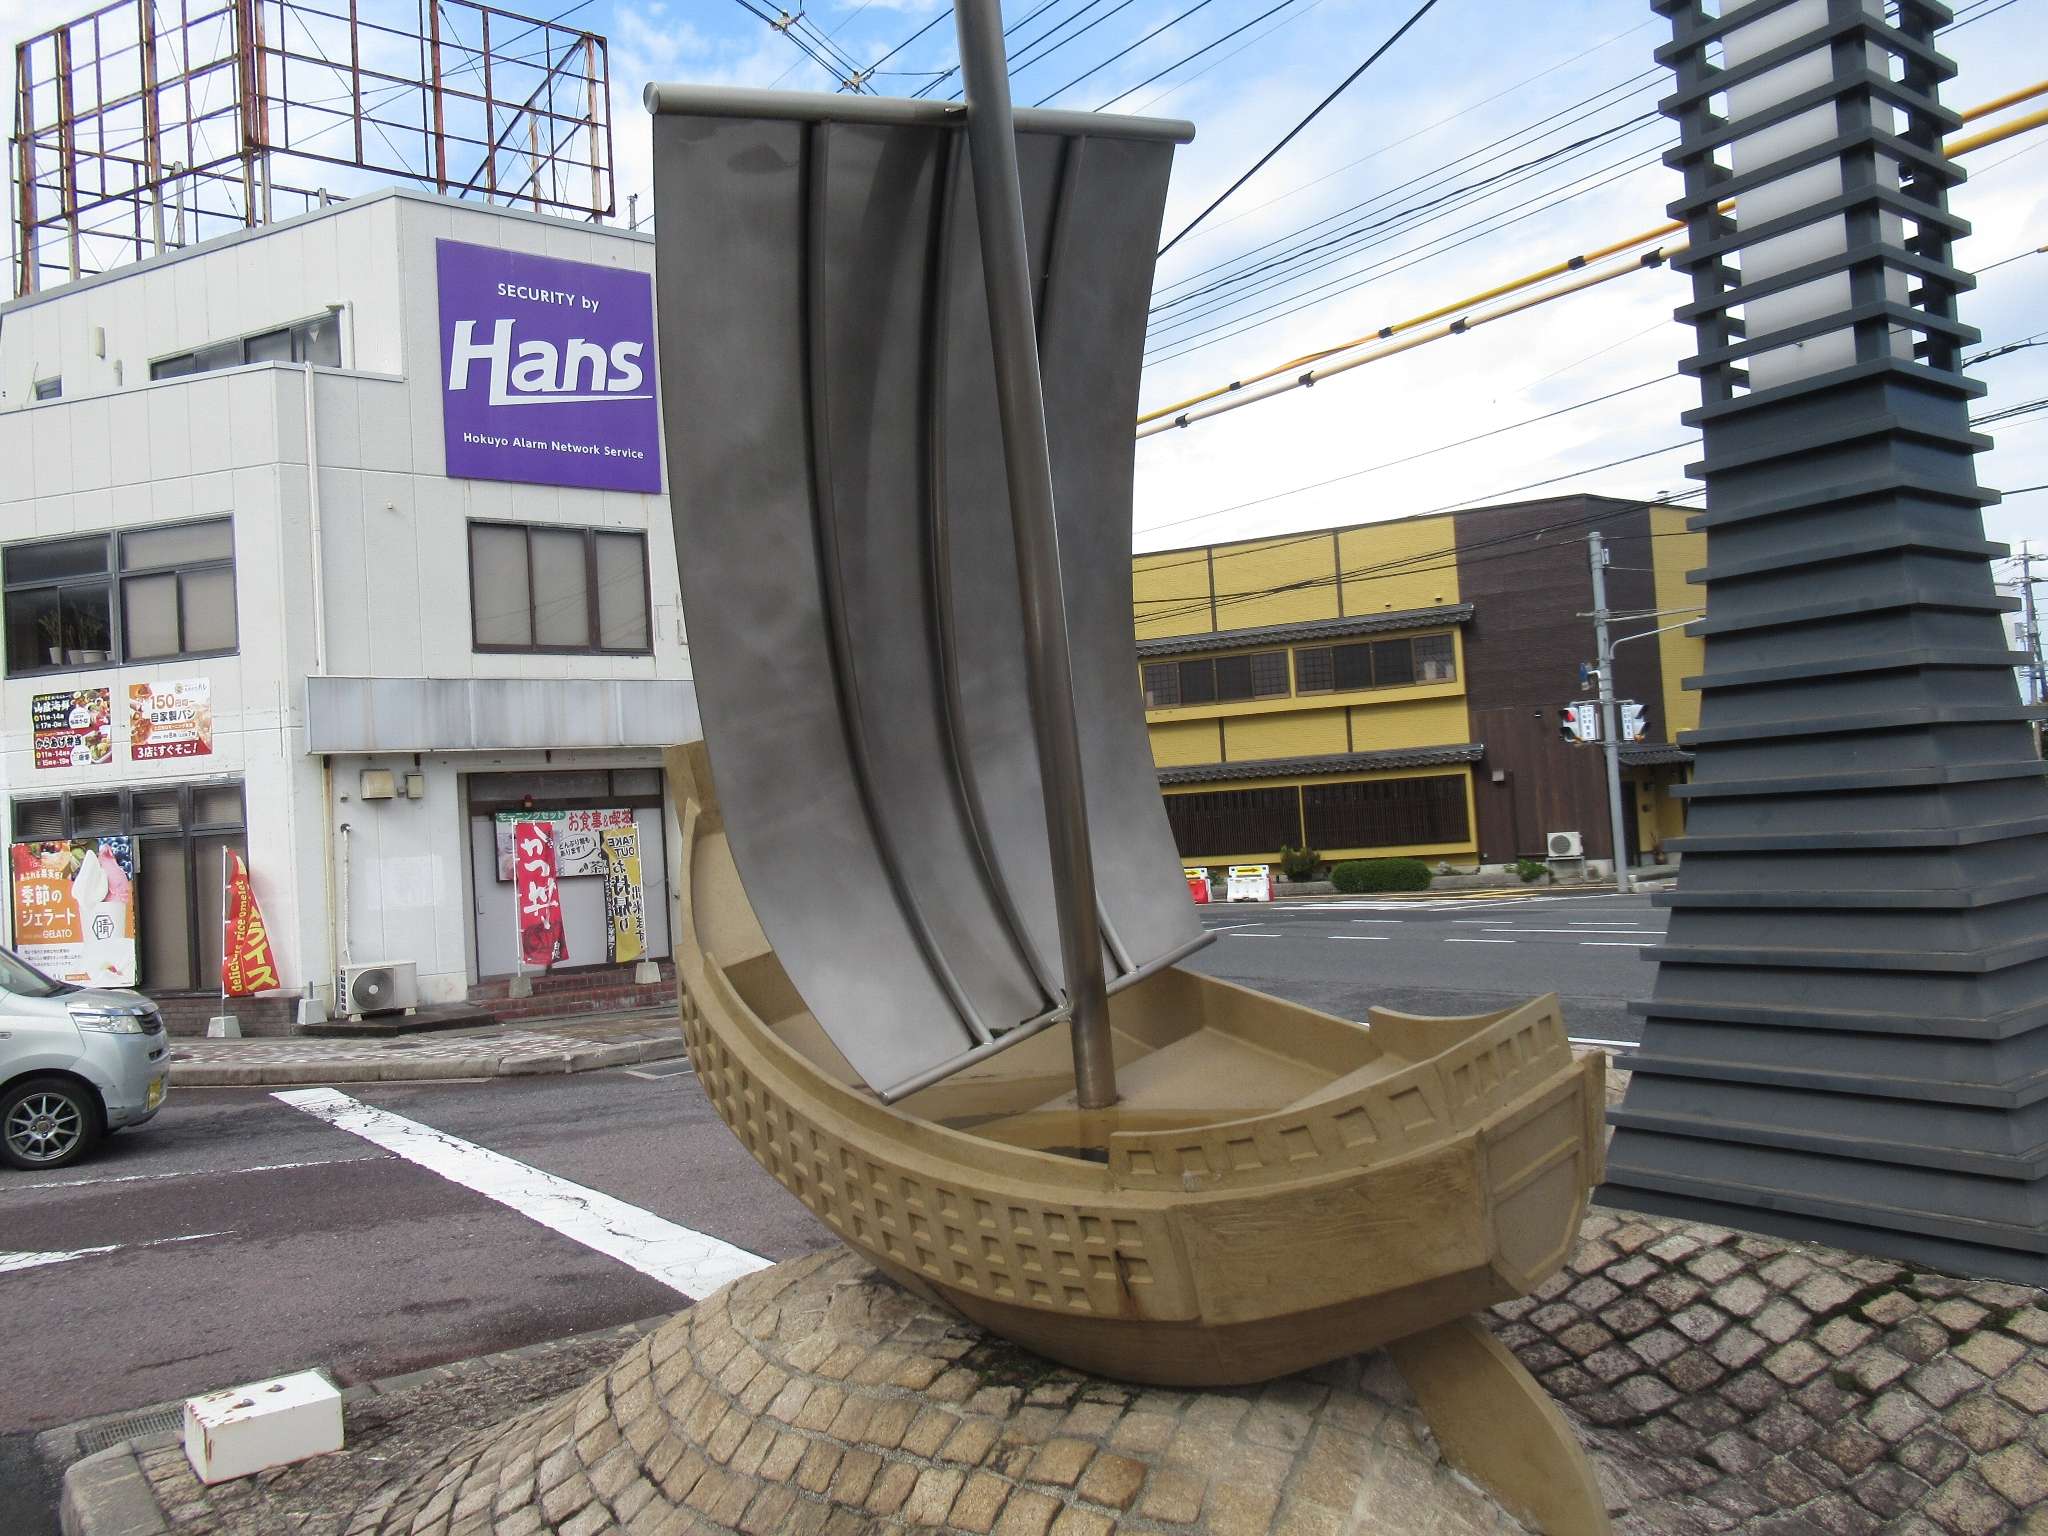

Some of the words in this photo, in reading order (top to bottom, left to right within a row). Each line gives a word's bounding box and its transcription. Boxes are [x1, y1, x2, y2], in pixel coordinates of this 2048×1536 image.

[498, 283, 575, 306] SECURITY
[582, 296, 600, 314] by
[449, 319, 653, 405] Hans
[463, 432, 509, 448] Hokuyo
[513, 437, 547, 450] Alarm
[551, 441, 600, 455] Network
[604, 445, 644, 459] Service
[151, 709, 196, 723] 自家製パン
[21, 884, 63, 907] 季節の
[22, 907, 76, 927] ジェラート
[43, 929, 73, 939] GELATO
